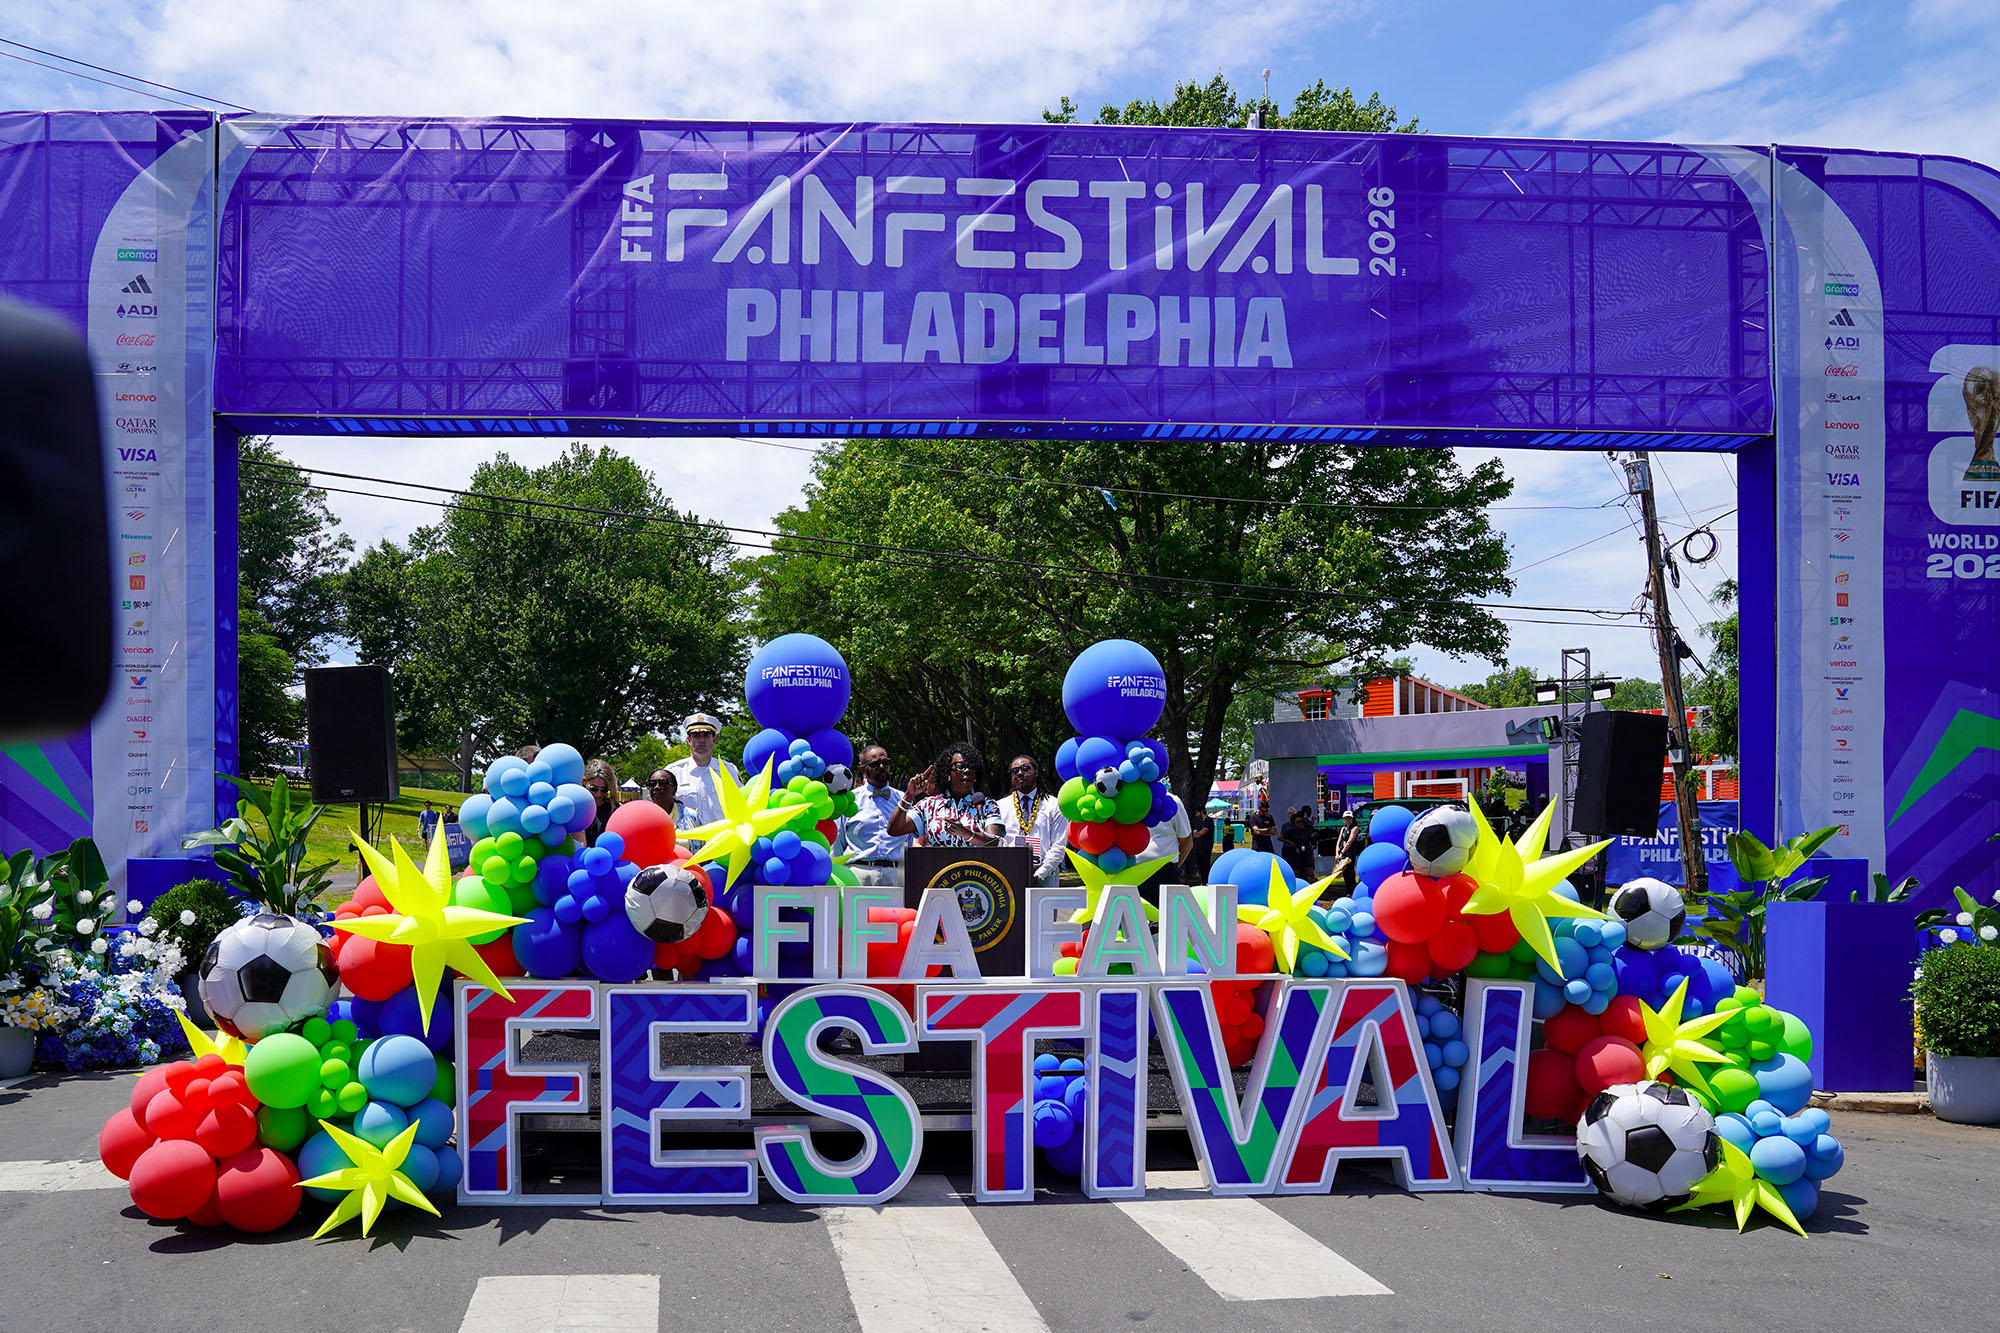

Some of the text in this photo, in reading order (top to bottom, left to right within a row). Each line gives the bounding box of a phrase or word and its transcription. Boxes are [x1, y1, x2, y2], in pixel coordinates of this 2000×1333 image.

[621, 174, 654, 262] FIFA
[1368, 186, 1396, 276] 2026
[118, 251, 157, 260] aramco
[1825, 286, 1858, 294] aramco
[127, 304, 157, 316] ADI
[726, 288, 1293, 369] PHILADELPHIA
[1834, 337, 1860, 347] ADI
[115, 392, 157, 402] Lenovo
[115, 417, 157, 428] QATAR
[1825, 420, 1860, 430] Lenovo
[116, 447, 157, 462] VISA
[1825, 444, 1860, 454] QATAR
[1825, 472, 1860, 486] VISA
[1927, 533, 1999, 550] WORLD
[1926, 553, 2000, 579] 202
[127, 627, 150, 636] Dove
[123, 646, 154, 654] verizon
[773, 677, 832, 688] PHILADELPHIA
[138, 787, 153, 795] PIF
[1843, 792, 1855, 800] PIF
[950, 869, 1006, 909] OF PHILADELPHIA
[753, 885, 982, 978] FIFA
[978, 917, 1003, 941] PARKER
[1025, 884, 1238, 978] FAN
[457, 978, 1597, 1203] FESTIVAL
